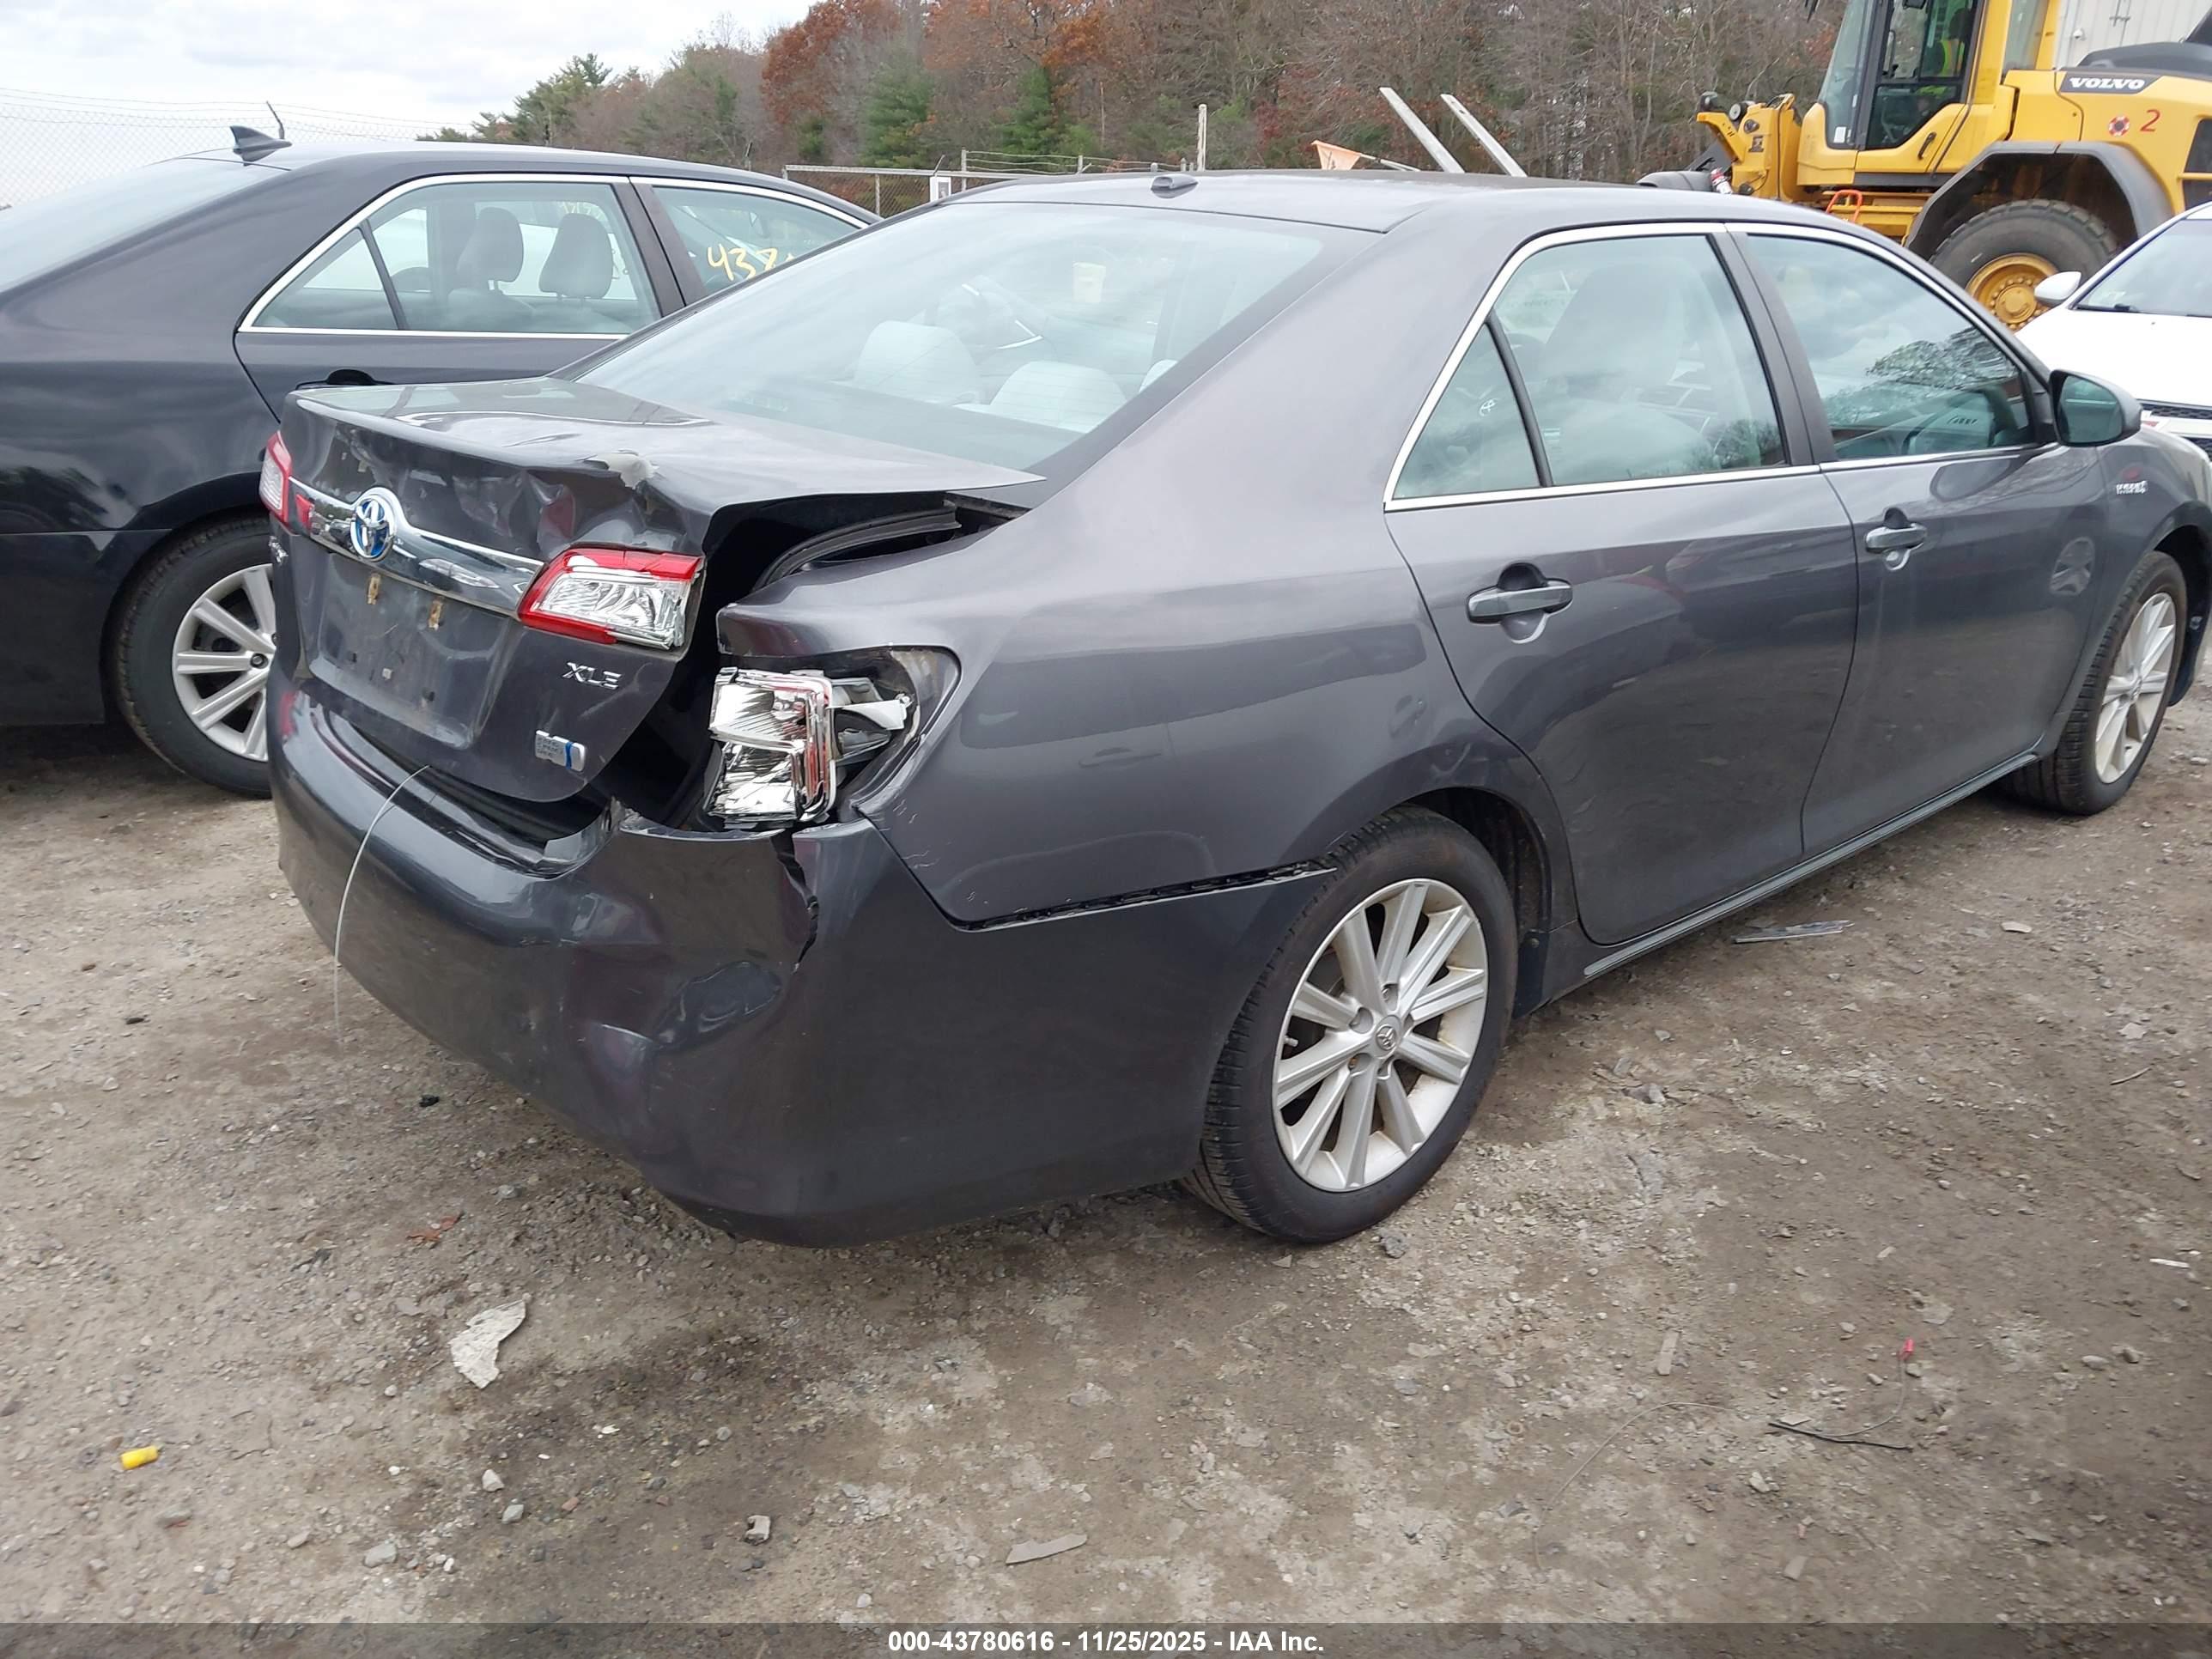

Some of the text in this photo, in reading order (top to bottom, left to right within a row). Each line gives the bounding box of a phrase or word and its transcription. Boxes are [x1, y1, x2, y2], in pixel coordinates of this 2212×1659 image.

[2069, 77, 2145, 90] VOLVO
[2140, 109, 2160, 131] 2
[707, 243, 794, 282] 437
[562, 661, 622, 690] XLE
